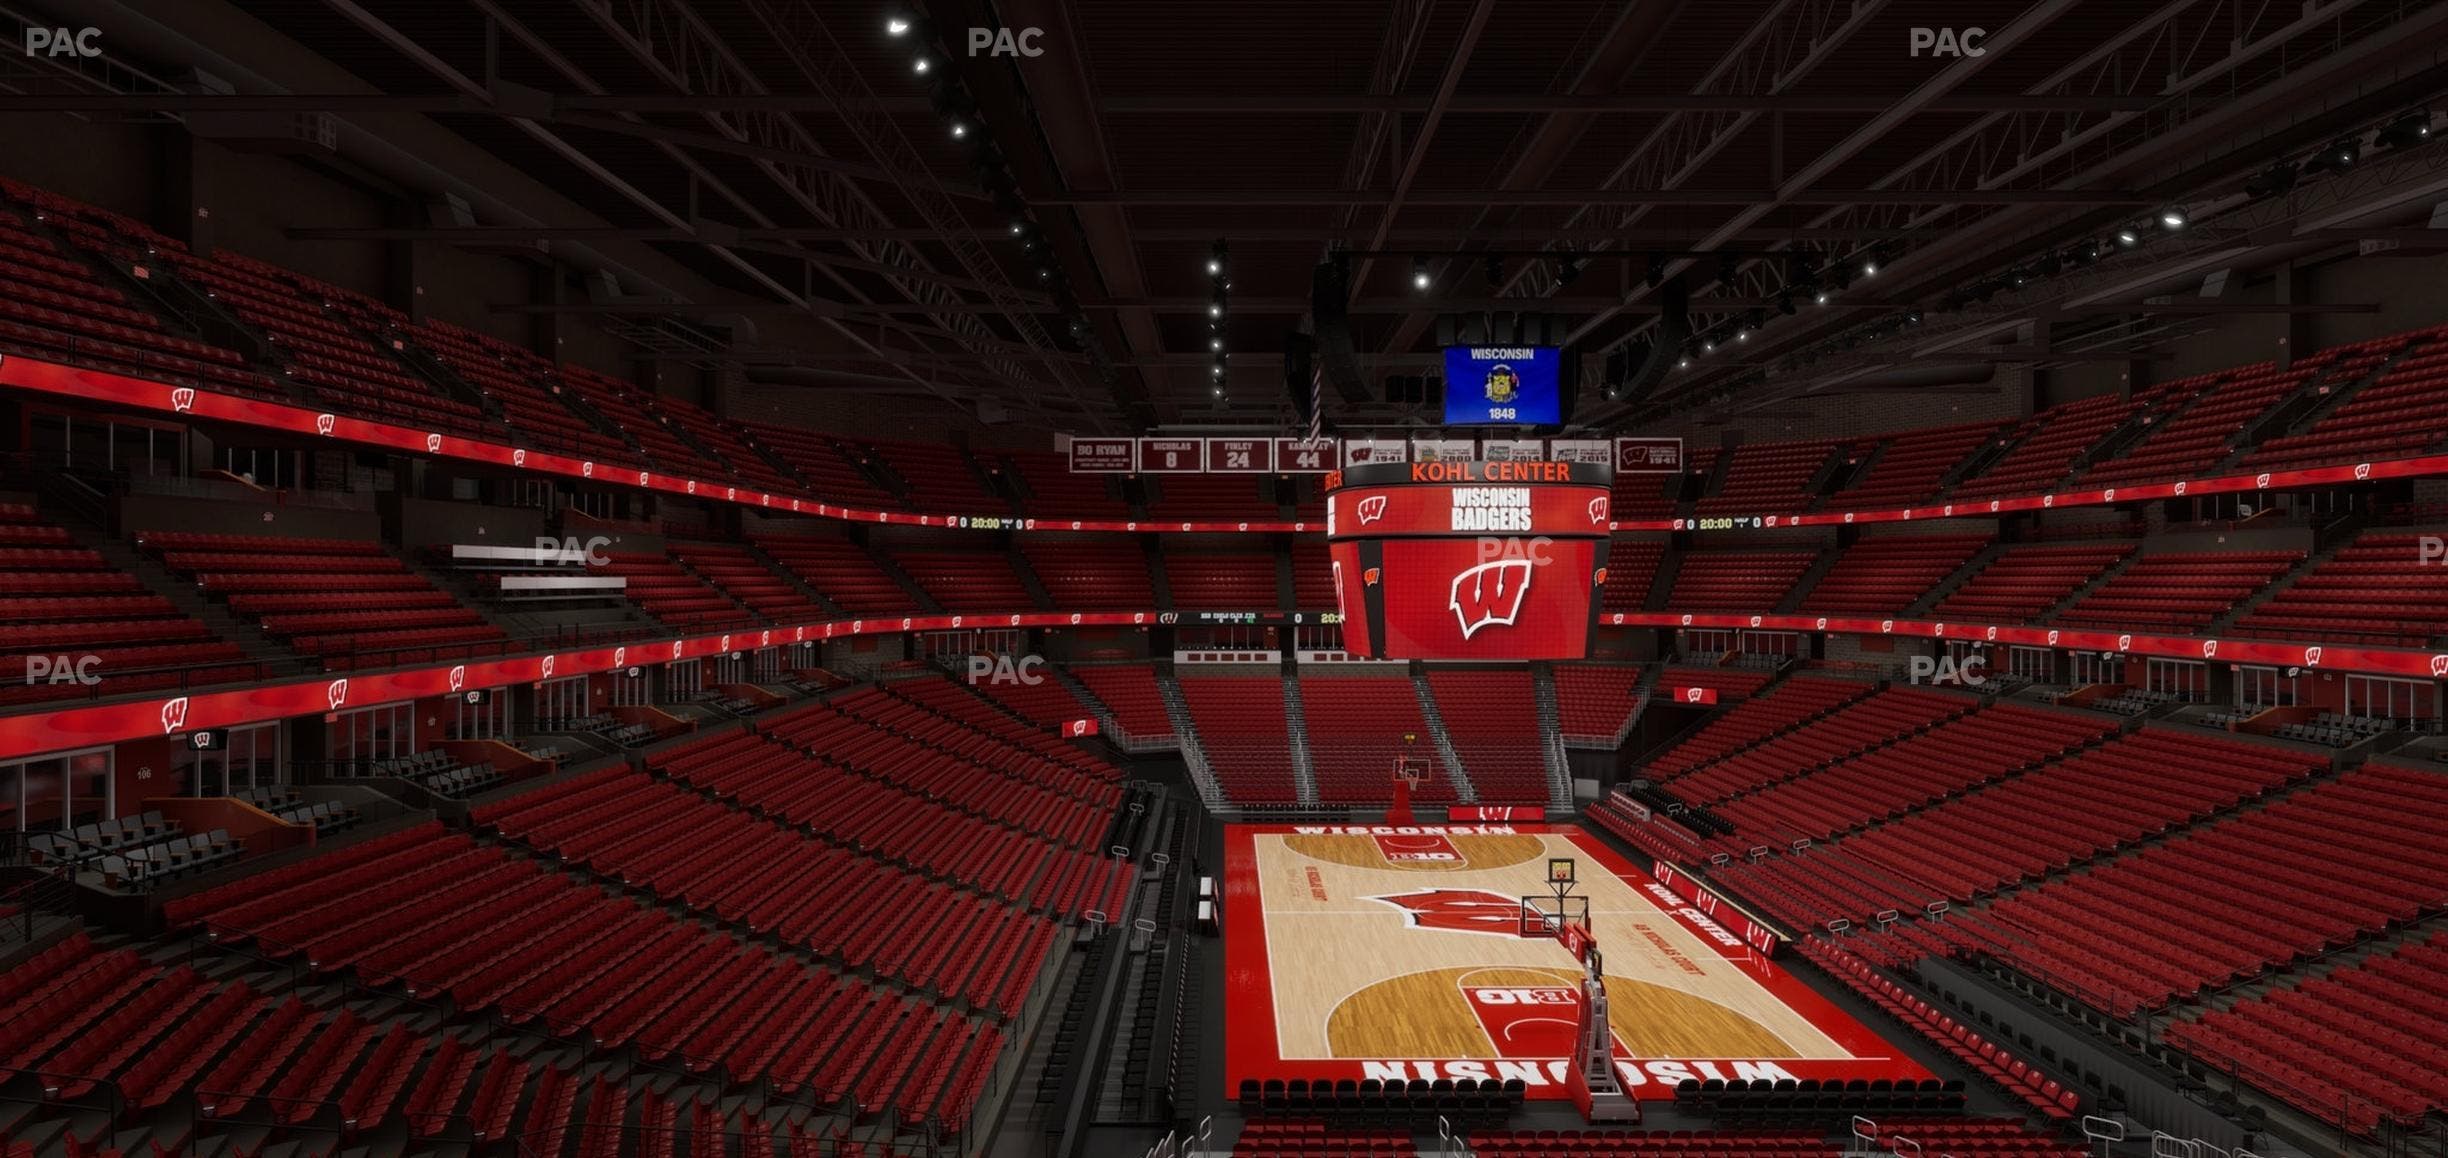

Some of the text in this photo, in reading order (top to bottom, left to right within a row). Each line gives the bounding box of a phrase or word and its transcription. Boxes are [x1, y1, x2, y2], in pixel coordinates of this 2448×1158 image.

[1471, 348, 1534, 360] WISCONSIN
[1488, 408, 1516, 420] 1848
[1076, 445, 1126, 456] BO RYAN
[1166, 452, 1177, 468] 8
[1227, 452, 1250, 468] 24
[1296, 452, 1320, 468] 44
[1411, 462, 1571, 481] KOHL CENTER
[1452, 487, 1531, 507] WISCONSIN
[1357, 495, 1387, 525] W
[1588, 496, 1607, 525] W
[971, 517, 1000, 529] 20:00
[1451, 507, 1532, 531] BADGERS
[1687, 519, 1695, 530] 0
[1699, 518, 1733, 529] 20:00
[1752, 517, 1761, 528] 0
[1447, 559, 1533, 639] W
[1294, 826, 1516, 835] WISCONSIN
[1644, 883, 1743, 946] KOHL CENTER
